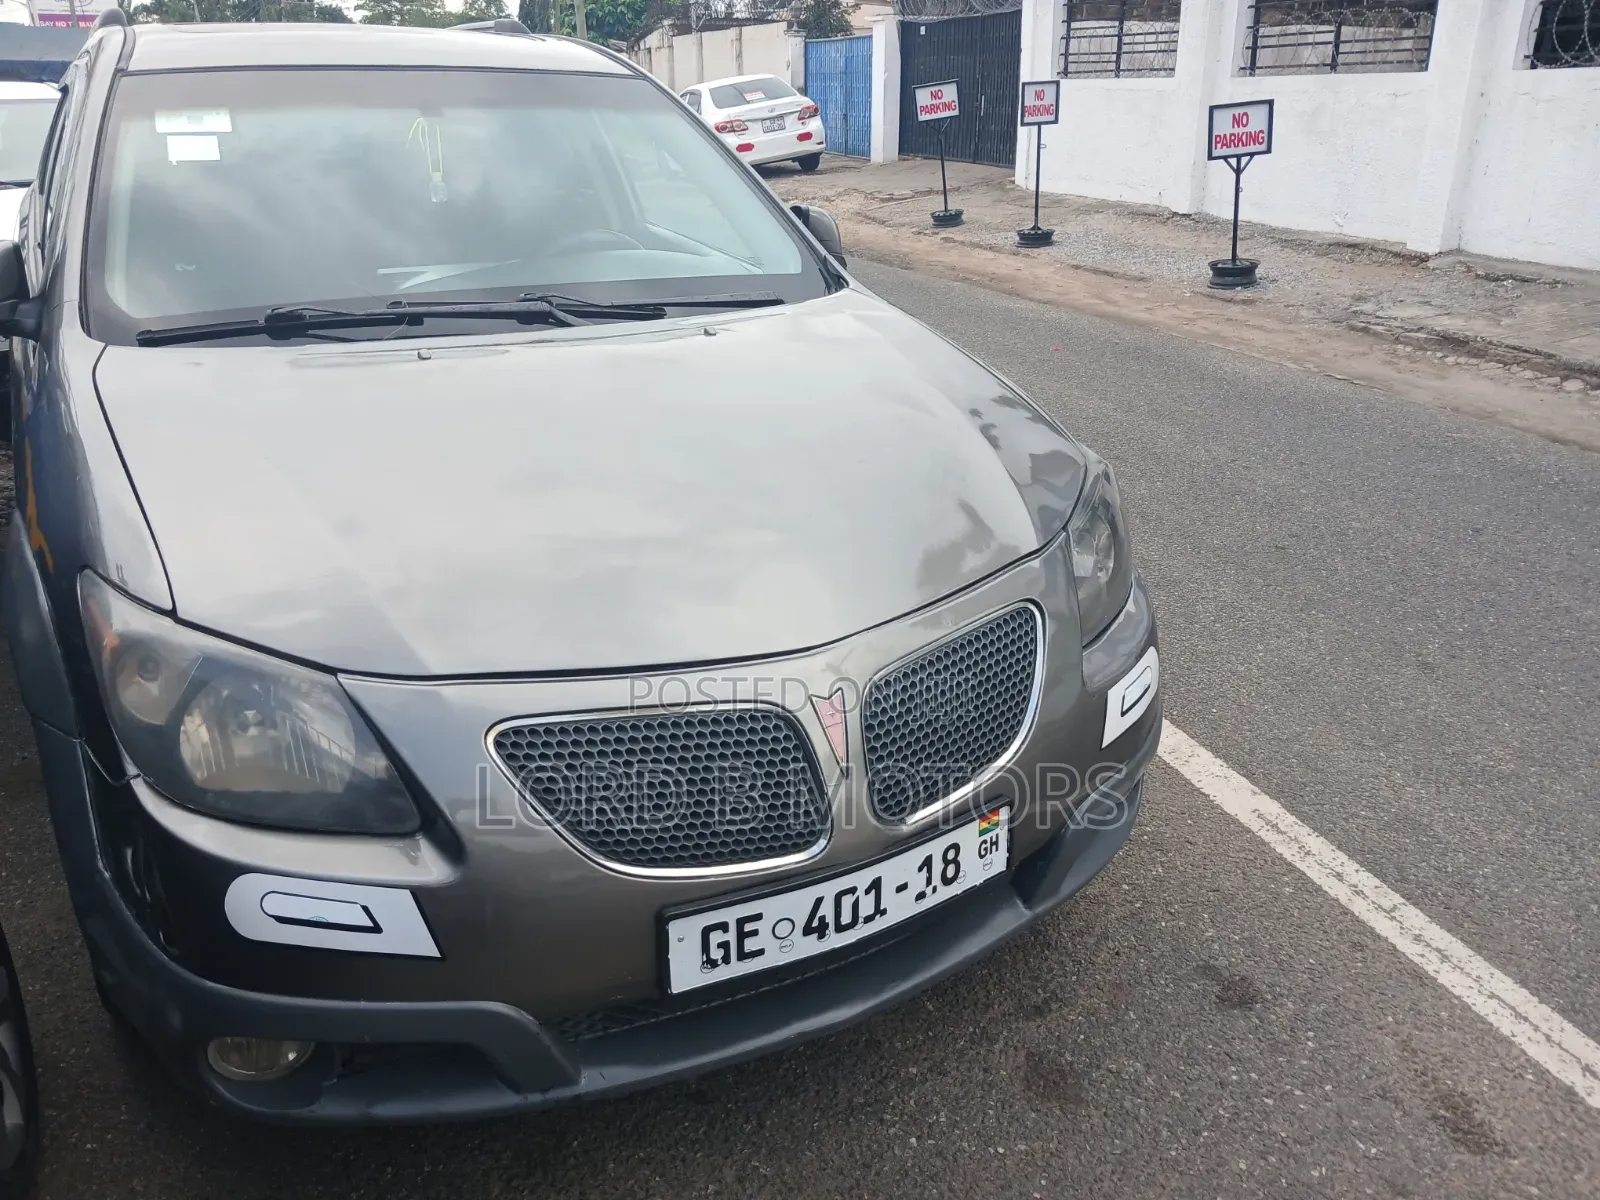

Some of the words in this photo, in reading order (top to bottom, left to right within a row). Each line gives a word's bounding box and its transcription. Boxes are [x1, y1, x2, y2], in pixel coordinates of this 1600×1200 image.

[930, 88, 943, 101] NO
[1034, 89, 1045, 101] NO
[919, 100, 957, 116] PARKING
[1023, 104, 1054, 117] PARKING
[1231, 111, 1249, 129] NO
[1214, 129, 1265, 150] PARKING
[978, 833, 999, 859] GH
[701, 912, 766, 968] GE
[802, 842, 962, 940] 401-18
